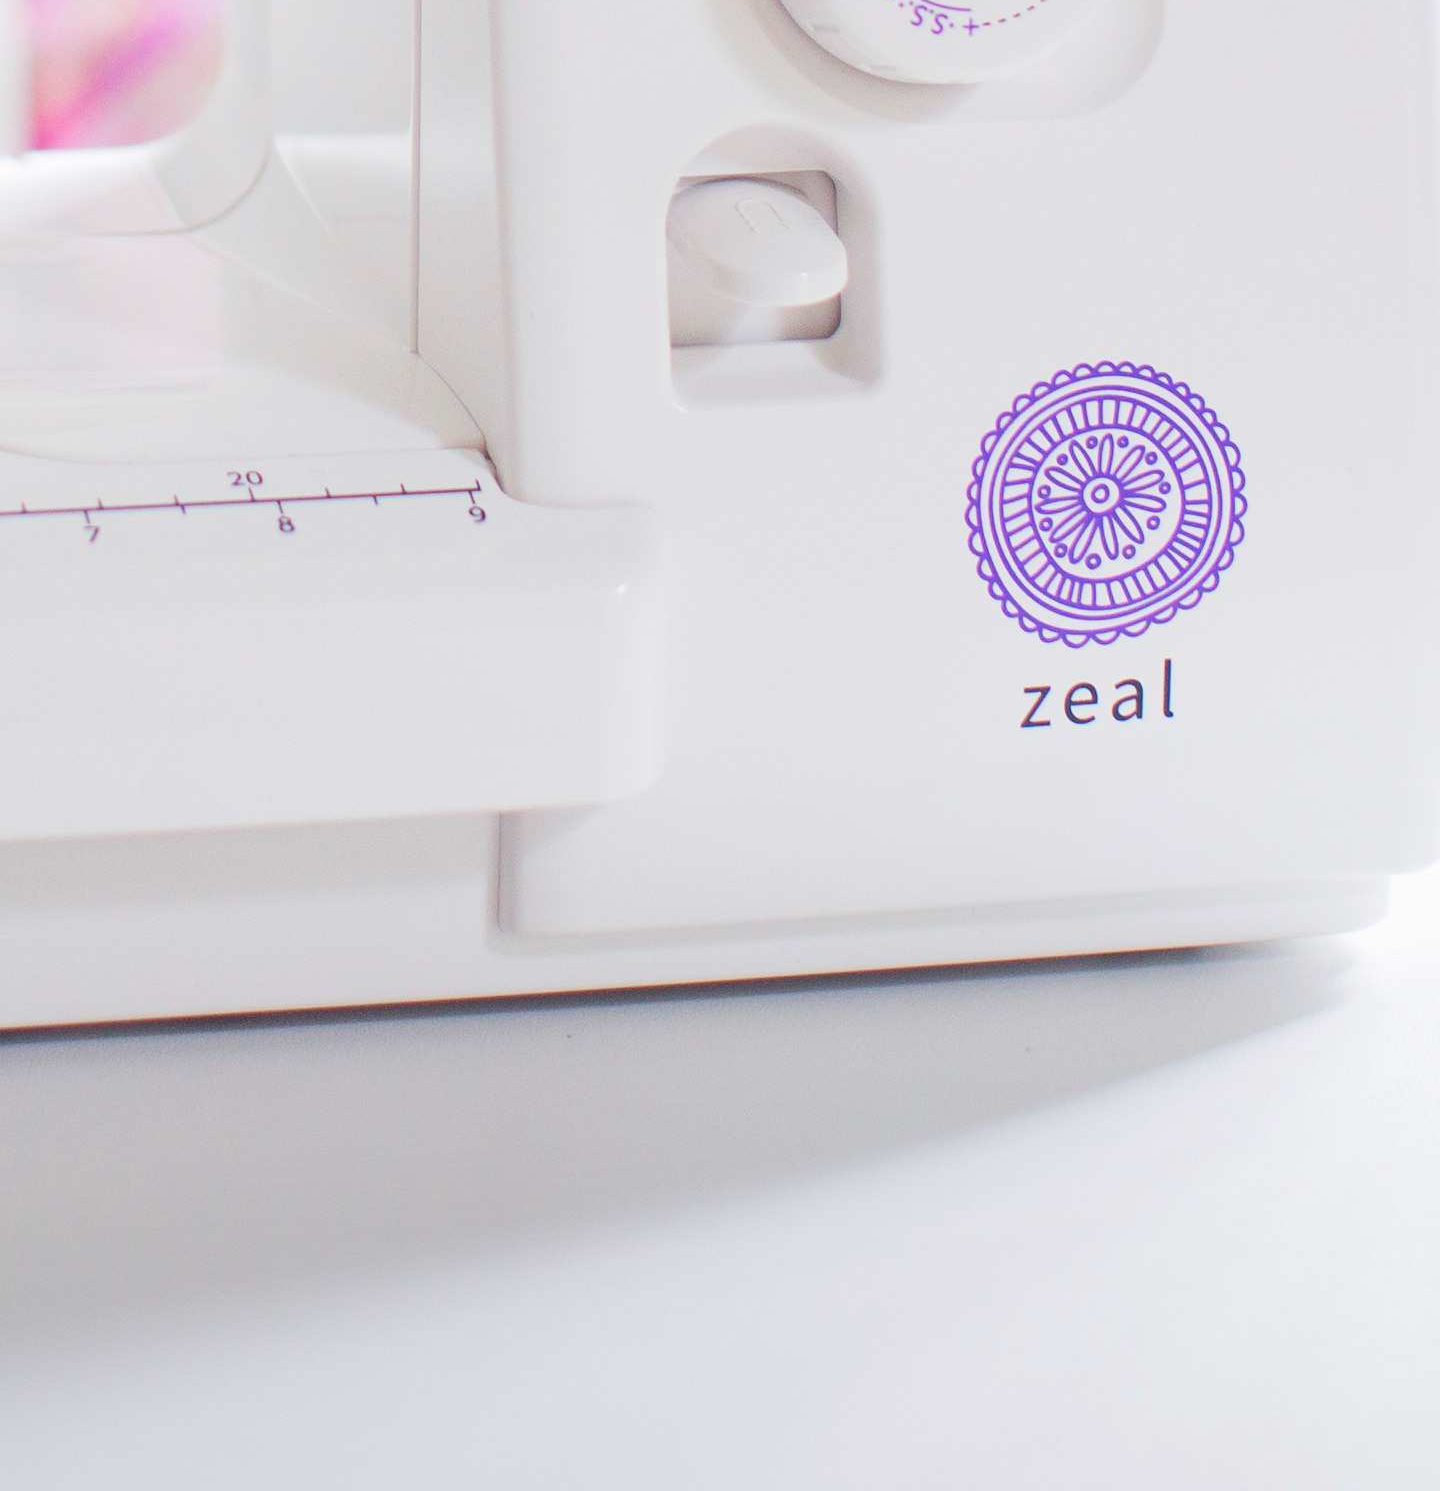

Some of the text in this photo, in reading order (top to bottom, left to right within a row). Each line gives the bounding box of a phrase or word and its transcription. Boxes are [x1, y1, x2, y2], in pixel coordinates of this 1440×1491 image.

[227, 470, 264, 487] 20
[84, 524, 99, 543] 7
[278, 515, 296, 533] 8
[468, 504, 488, 523] 9
[1020, 658, 1174, 728] zeal
